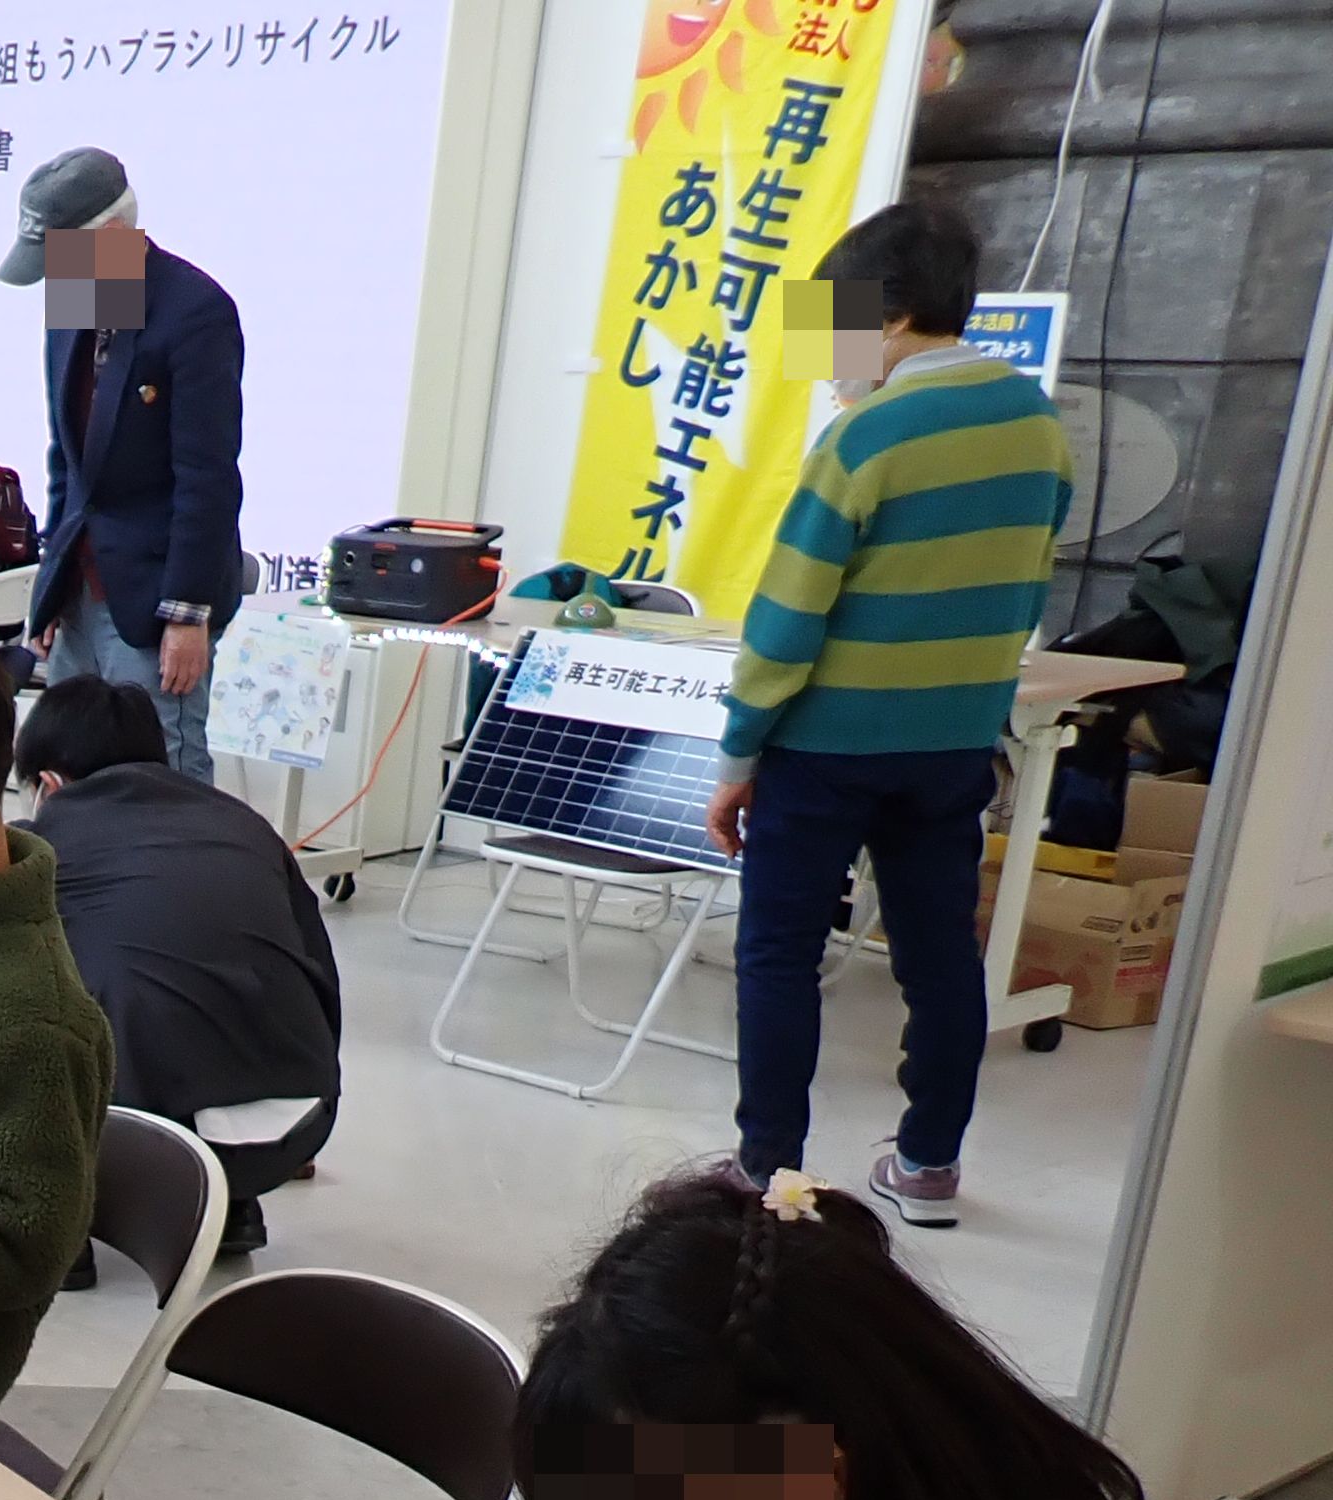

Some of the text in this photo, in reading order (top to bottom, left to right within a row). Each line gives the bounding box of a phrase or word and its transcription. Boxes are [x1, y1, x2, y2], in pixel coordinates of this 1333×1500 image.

[787, 11, 853, 62] 法人
[619, 161, 719, 389] あかし
